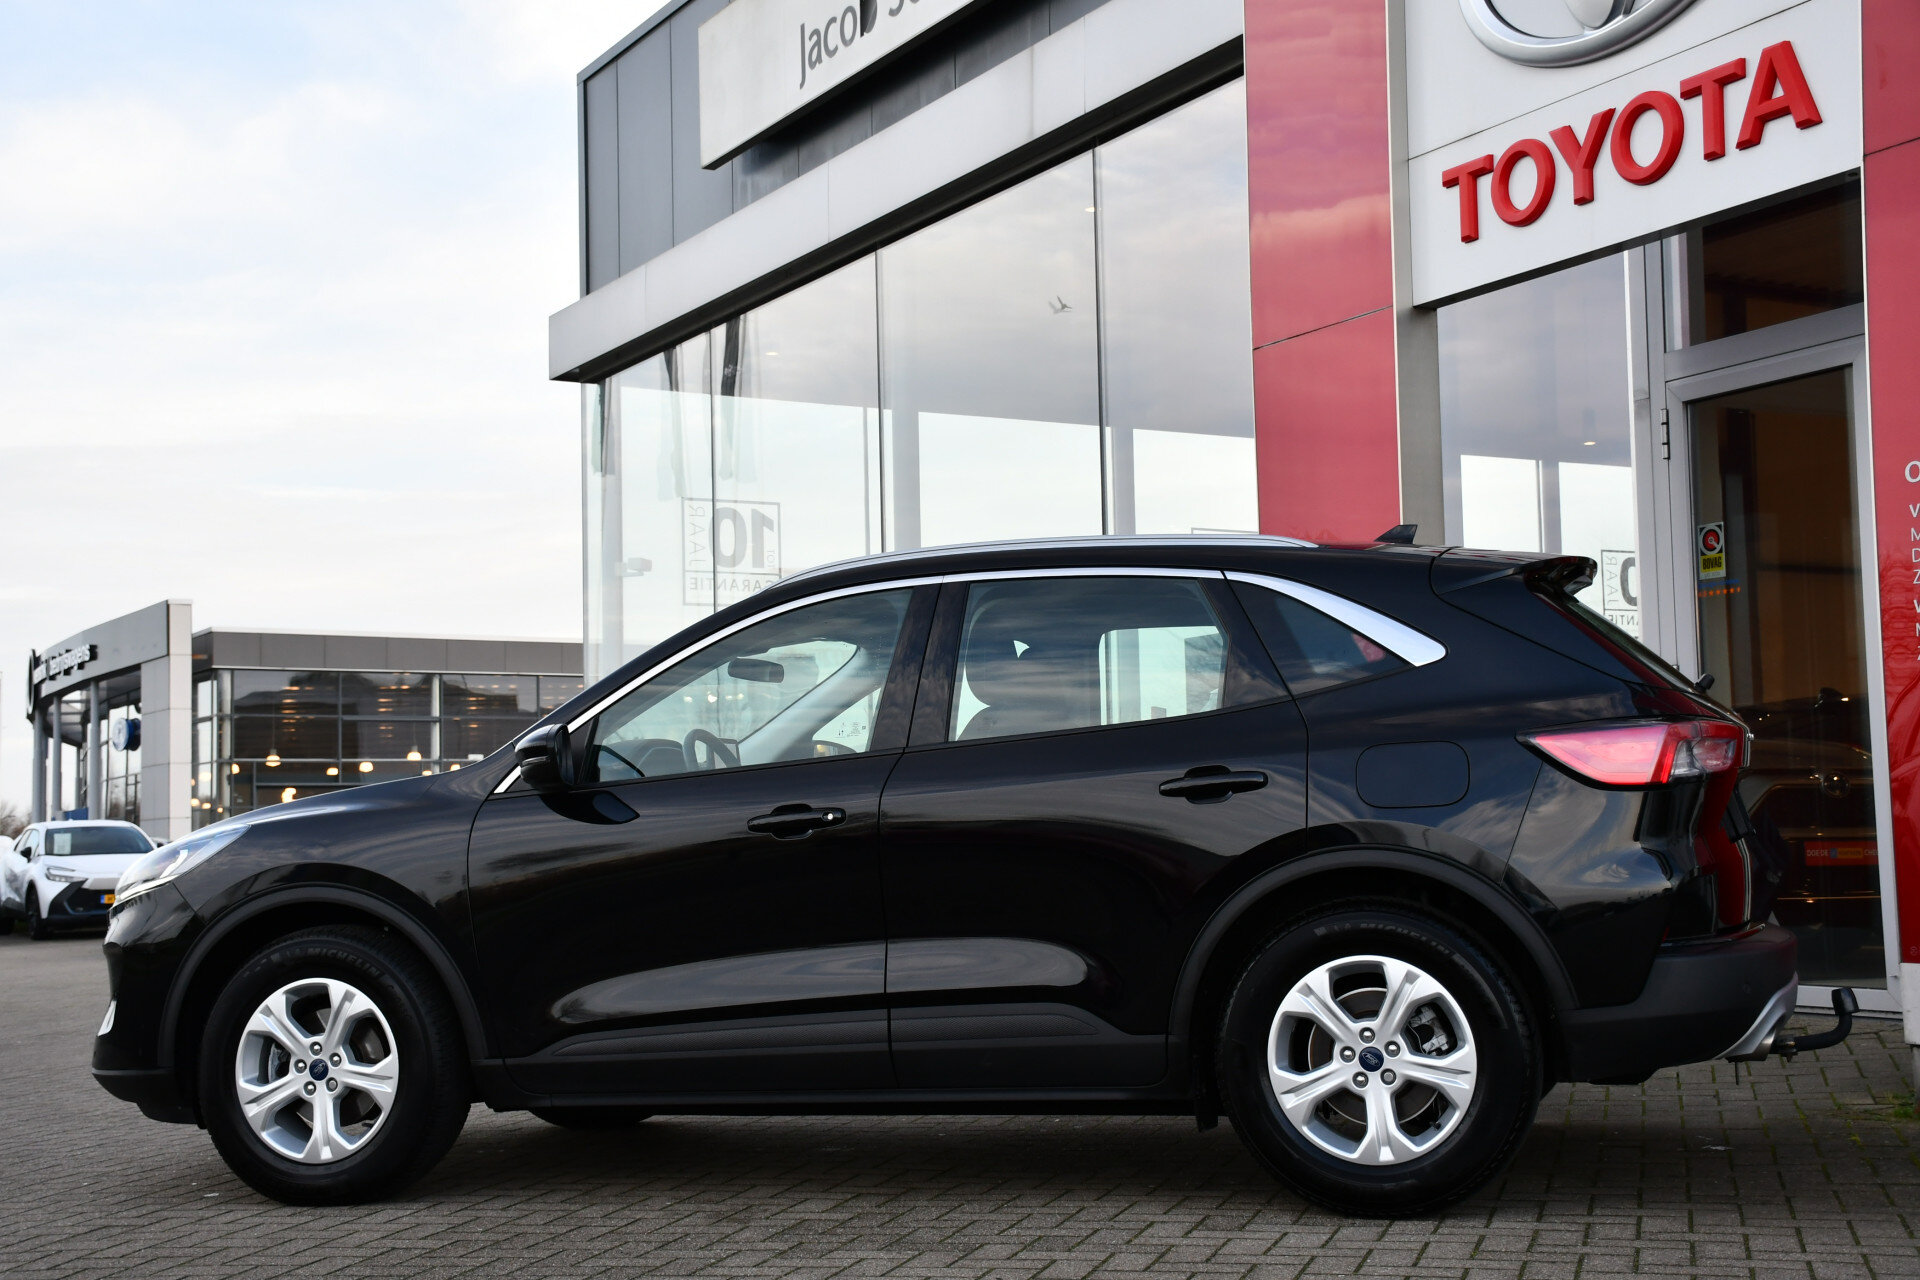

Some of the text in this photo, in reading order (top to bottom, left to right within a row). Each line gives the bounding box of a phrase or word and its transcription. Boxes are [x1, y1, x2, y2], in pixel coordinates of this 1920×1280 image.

[1441, 39, 1823, 243] TOYOTA
[1702, 556, 1722, 570] BOVAG
[306, 947, 382, 979] MICHELIN
